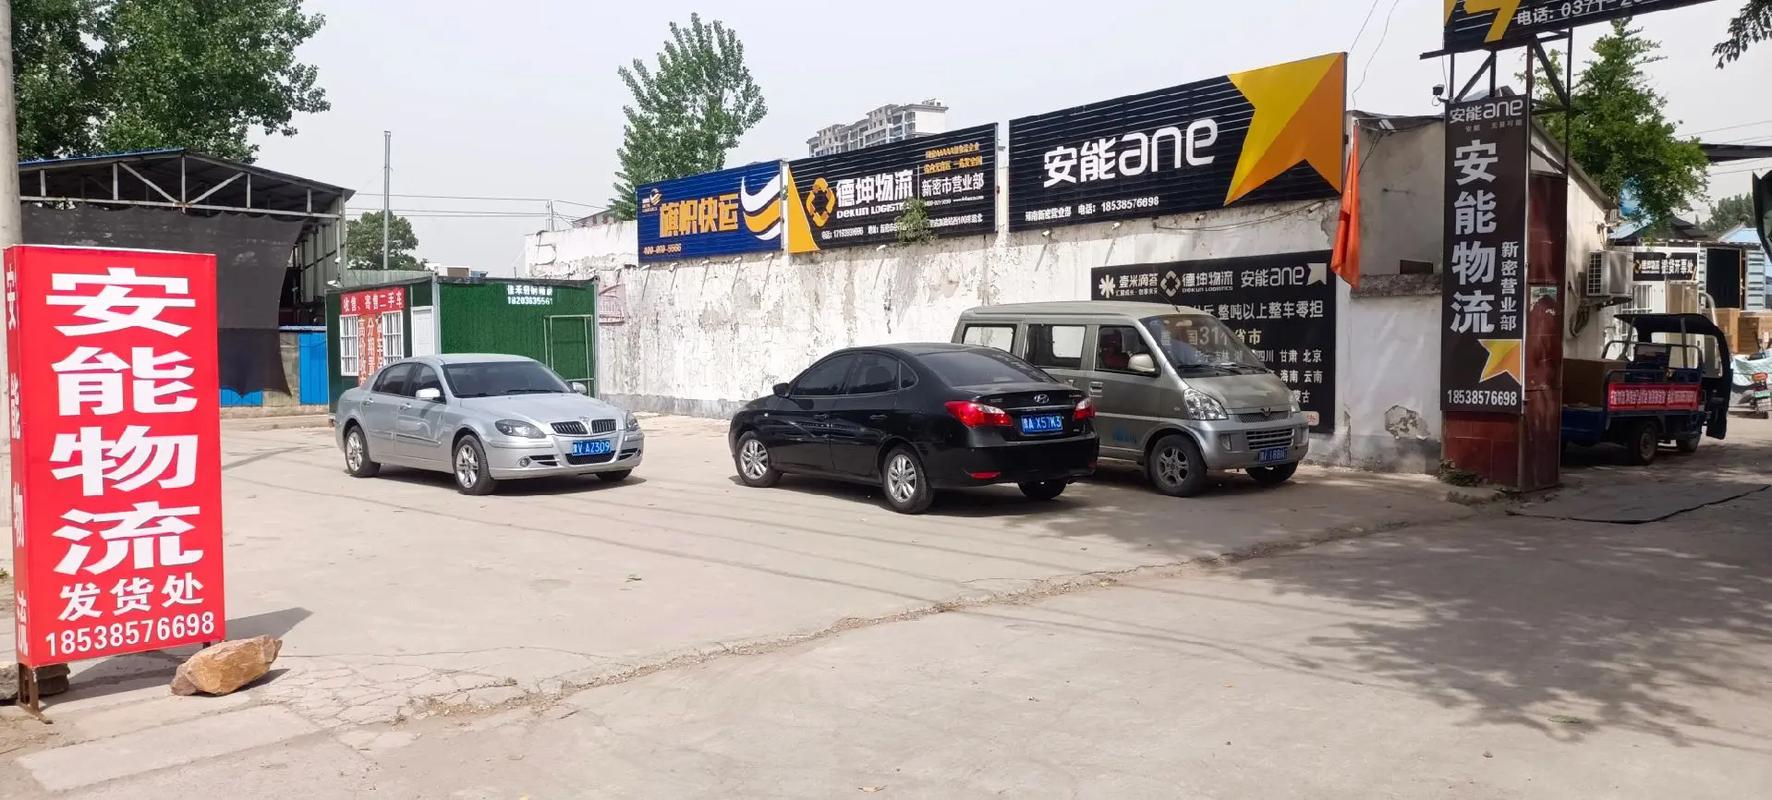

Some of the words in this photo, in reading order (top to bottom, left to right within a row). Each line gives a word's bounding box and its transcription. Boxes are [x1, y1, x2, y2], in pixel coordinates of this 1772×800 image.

[1449, 99, 1523, 124] 安能ane
[1043, 118, 1218, 188] 安能ane
[836, 170, 914, 207] 德坤物流
[921, 172, 985, 198] 新密市营业部
[660, 193, 739, 238] 旗帜快运
[1101, 196, 1159, 213] 18538576698
[1450, 139, 1498, 333] 安能物流
[1182, 270, 1233, 286] 德坤物流
[1240, 266, 1305, 288] 安能ane
[1500, 241, 1519, 331] 新密营业部
[1218, 300, 1323, 320] 整吨以上整车零担
[1279, 349, 1298, 363] 甘肃
[1303, 349, 1322, 363] 北京
[1280, 370, 1298, 383] 海南
[1304, 370, 1323, 384] 云南
[1446, 389, 1518, 407] 18538576698
[46, 266, 205, 576] 安能物流
[58, 573, 205, 622] 发货处
[45, 612, 215, 657] 18538576698
